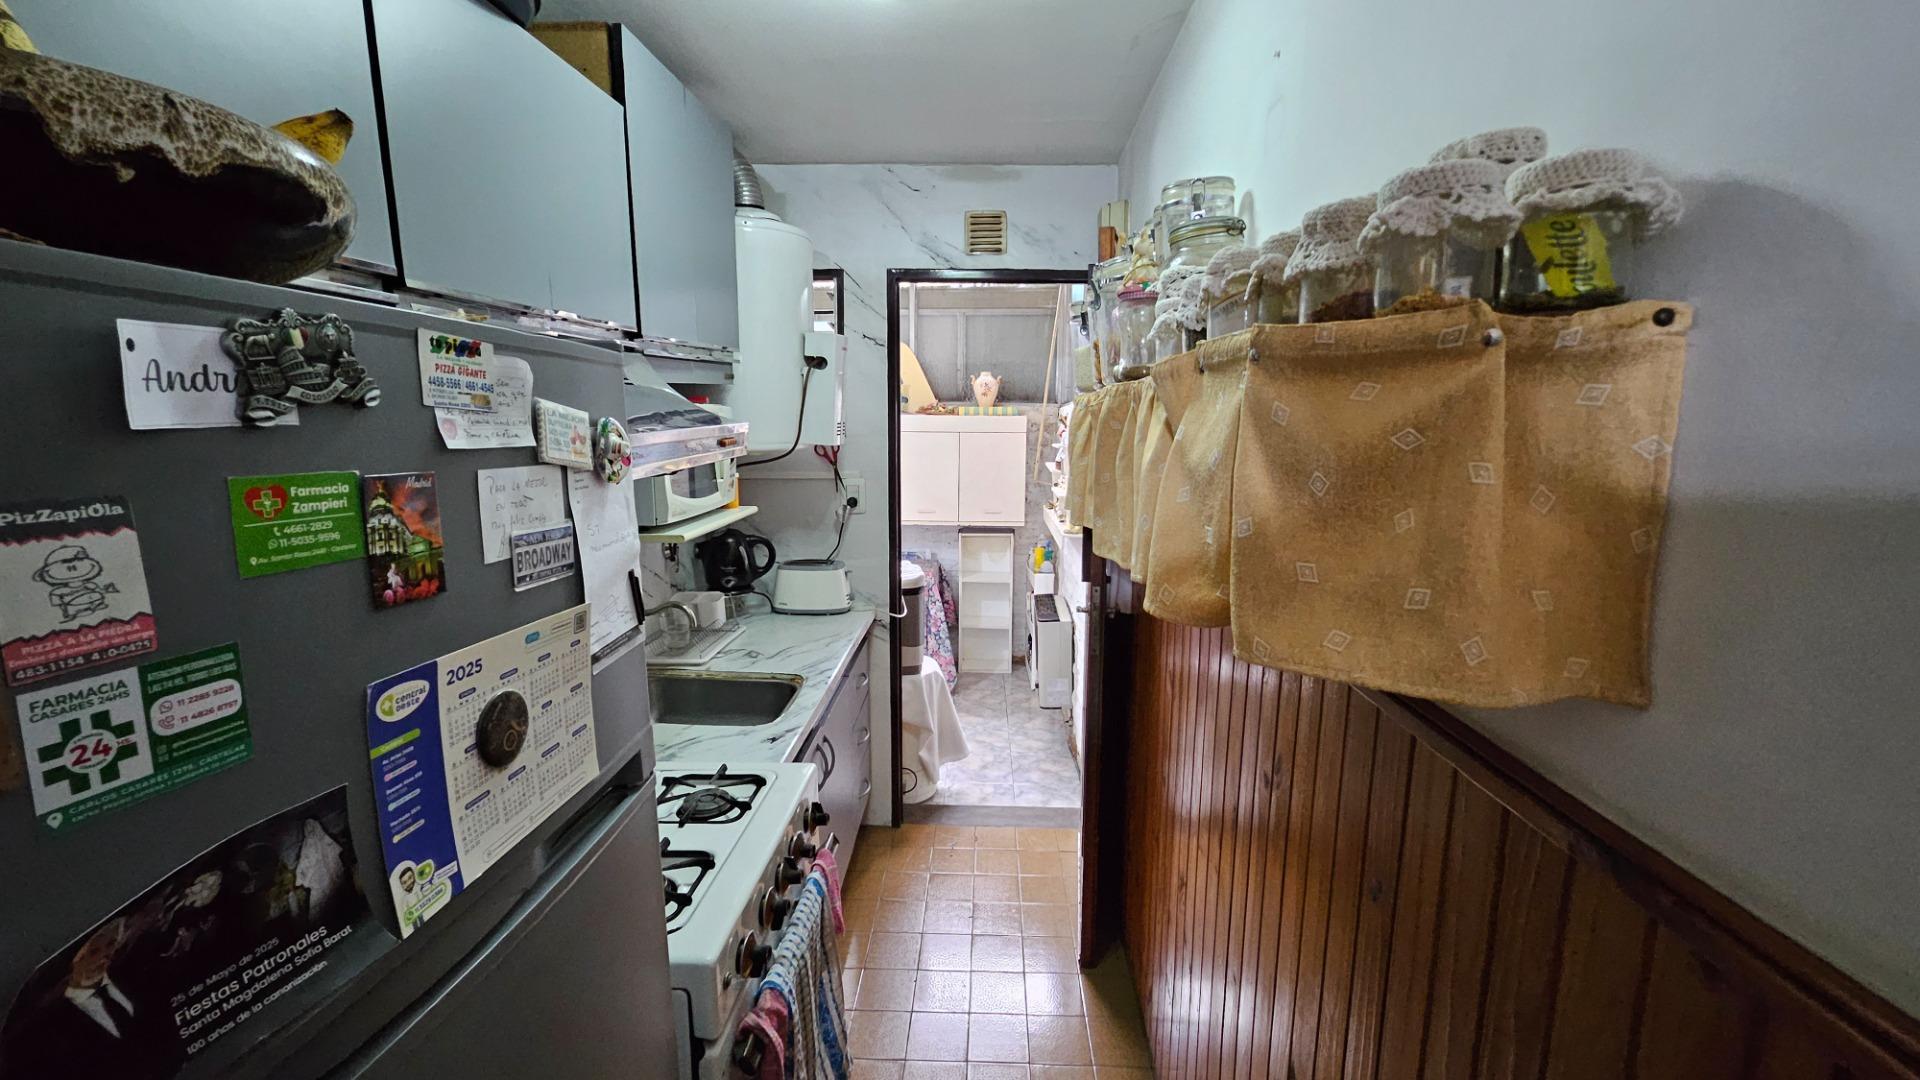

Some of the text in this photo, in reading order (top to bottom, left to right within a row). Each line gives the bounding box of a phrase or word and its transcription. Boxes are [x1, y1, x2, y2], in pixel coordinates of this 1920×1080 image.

[142, 358, 238, 393] Andr
[435, 363, 487, 379] PIZZA GIGANTE
[290, 482, 350, 497] Farmacia
[405, 476, 432, 488] Madrid
[292, 496, 348, 514] Zampieri
[516, 542, 572, 573] BROADWAY
[446, 658, 483, 686] 2025
[29, 679, 128, 715] FARMACIA
[29, 689, 130, 723] CASARES 24HS
[395, 685, 427, 704] central
[395, 696, 420, 713] oeste
[69, 738, 112, 767] 24
[69, 792, 117, 814] CARLOS
[120, 773, 169, 795] CASARES
[170, 936, 279, 1007] 25 de Mayo de 2025
[175, 926, 328, 1026] Fiestas Patronales
[180, 1008, 221, 1039] Santa
[222, 963, 293, 1011] Magdalena
[323, 925, 352, 948] Barat
[187, 1039, 206, 1055] 100
[207, 1020, 236, 1042] años
[236, 1010, 251, 1023] de
[252, 1002, 263, 1014] la
